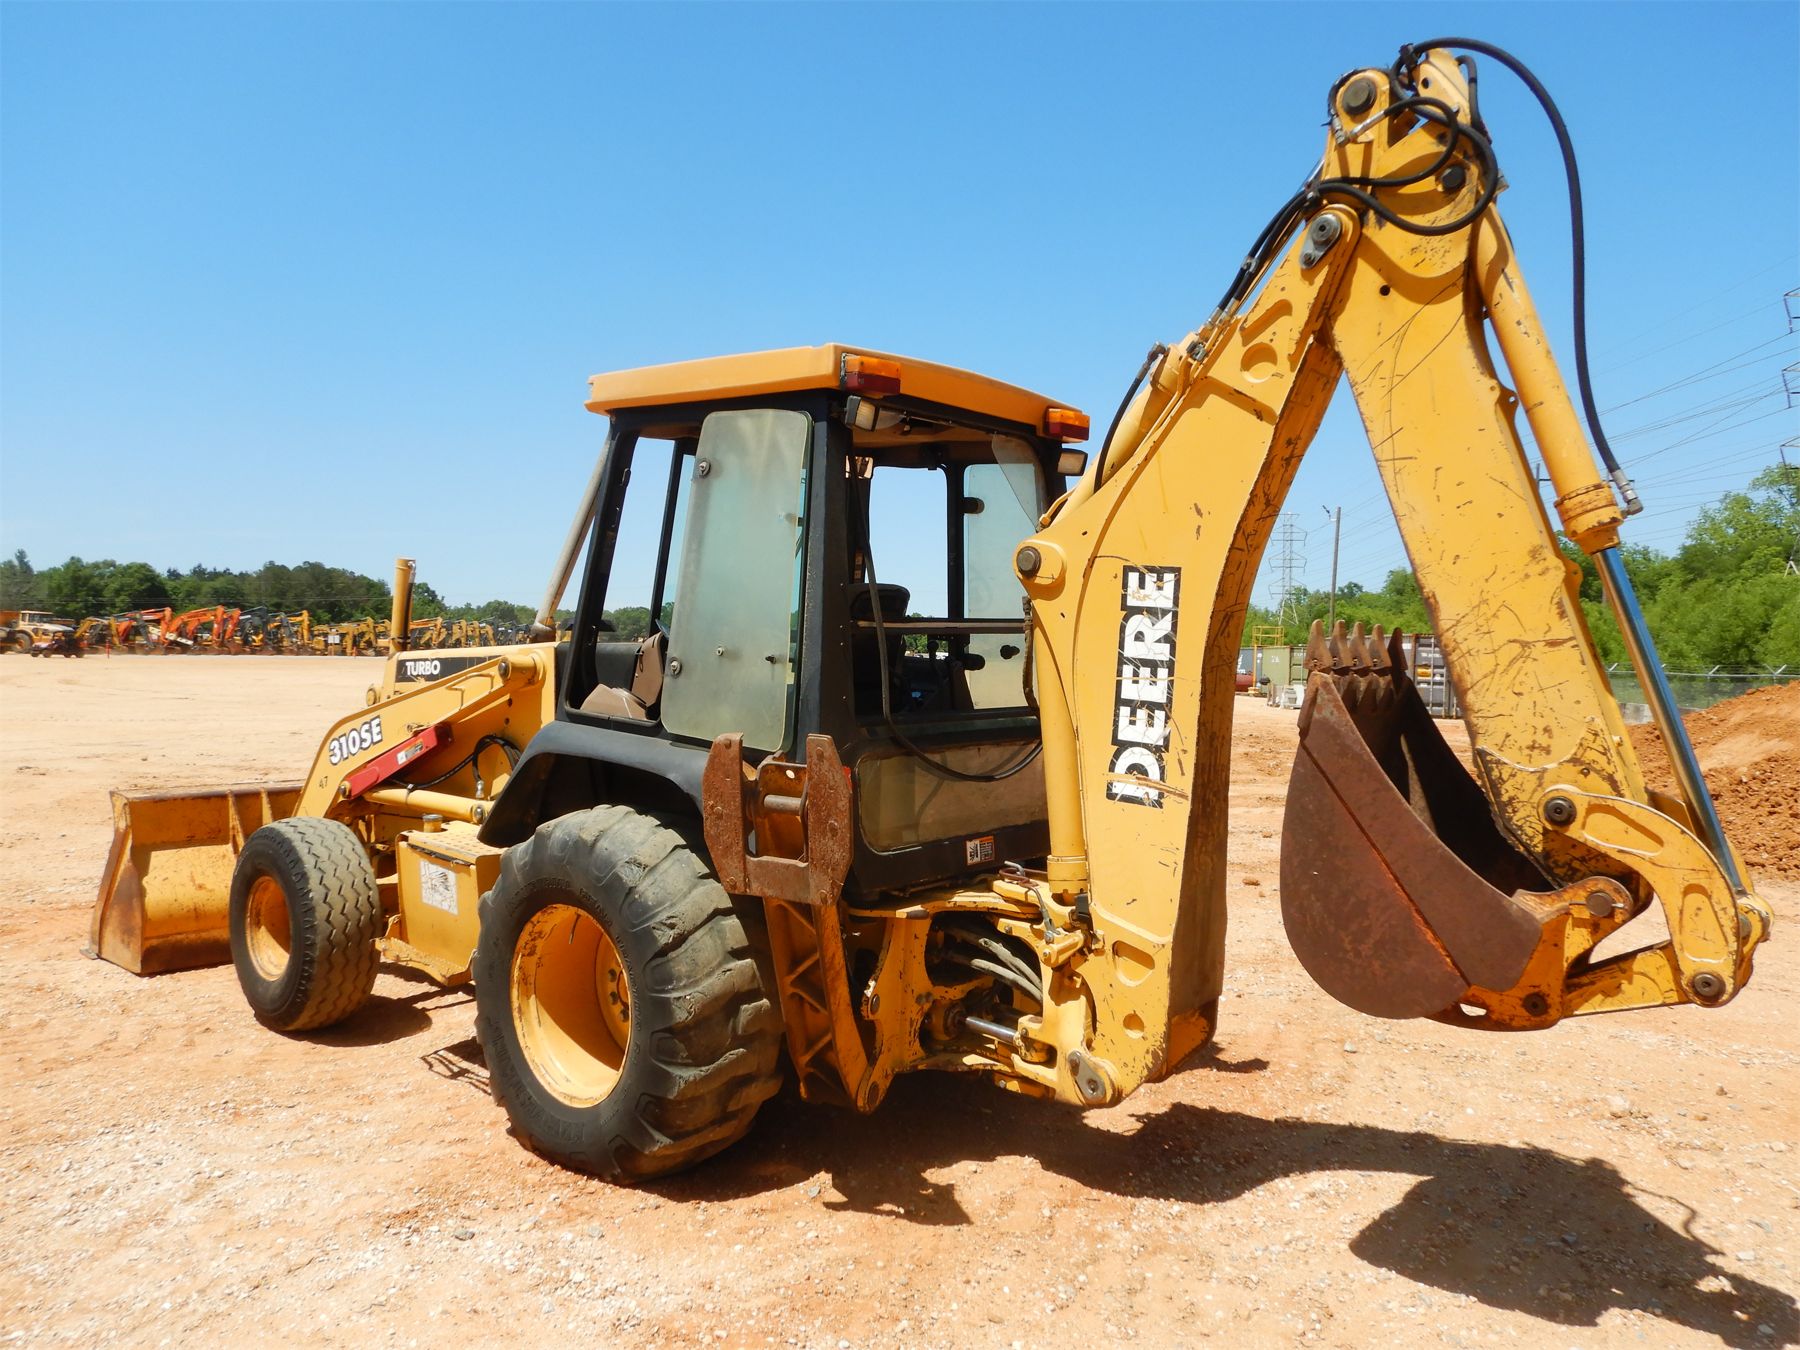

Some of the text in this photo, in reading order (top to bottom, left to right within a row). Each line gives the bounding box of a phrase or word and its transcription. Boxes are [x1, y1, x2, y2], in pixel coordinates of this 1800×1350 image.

[405, 660, 441, 676] TURBO
[1111, 571, 1176, 801] DEERE
[329, 716, 382, 765] 310SE
